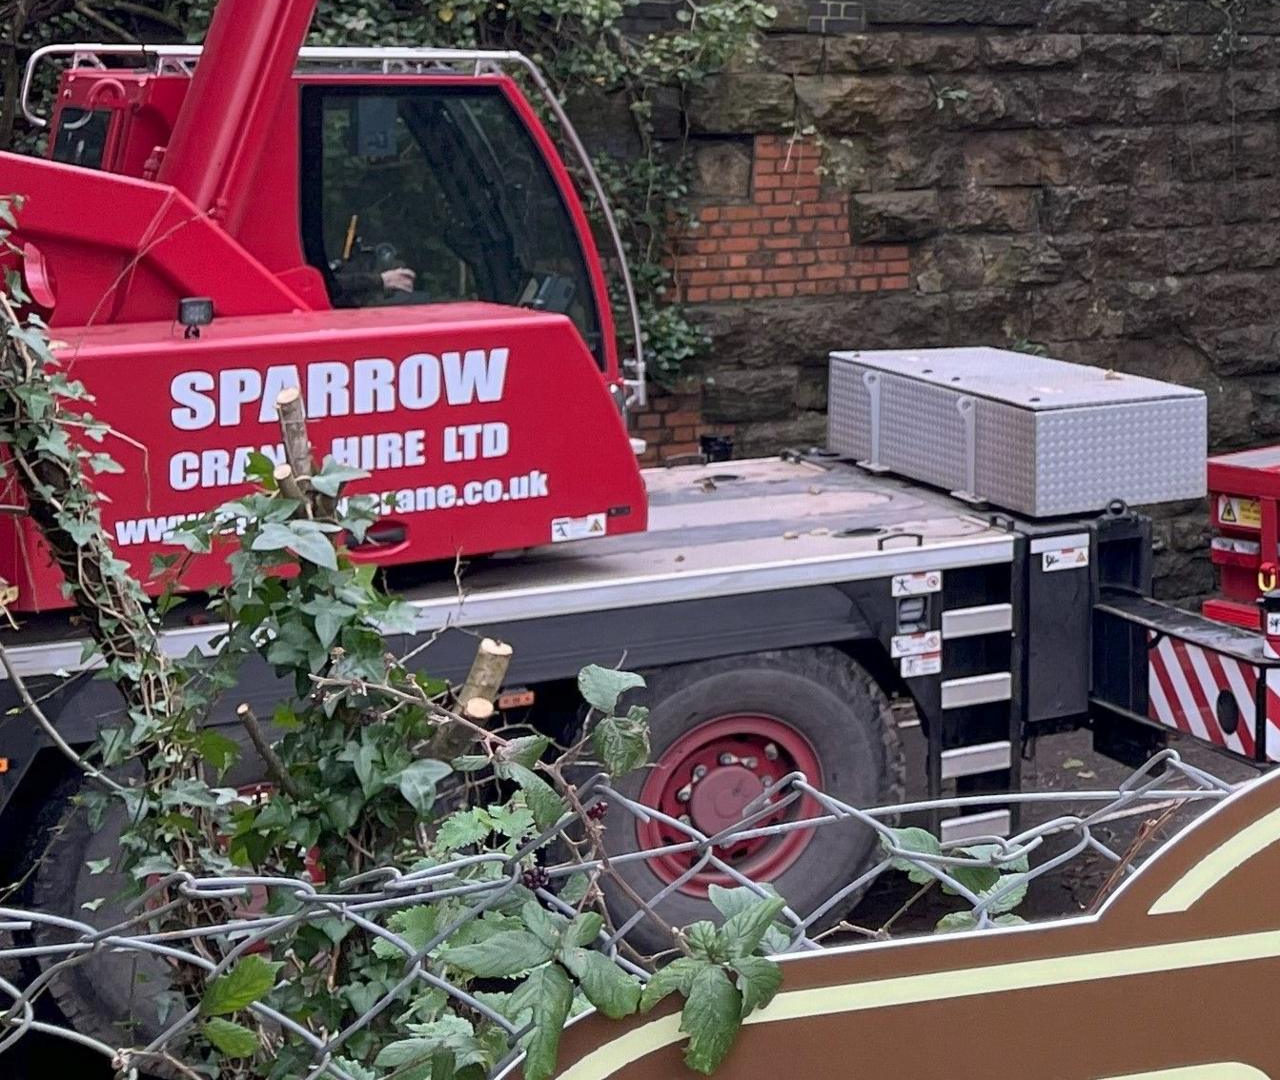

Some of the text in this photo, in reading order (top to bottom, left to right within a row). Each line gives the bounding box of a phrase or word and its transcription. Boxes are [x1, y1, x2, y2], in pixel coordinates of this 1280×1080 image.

[170, 347, 510, 430] SPARROW
[169, 422, 509, 491] CRAN HIRE LTD
